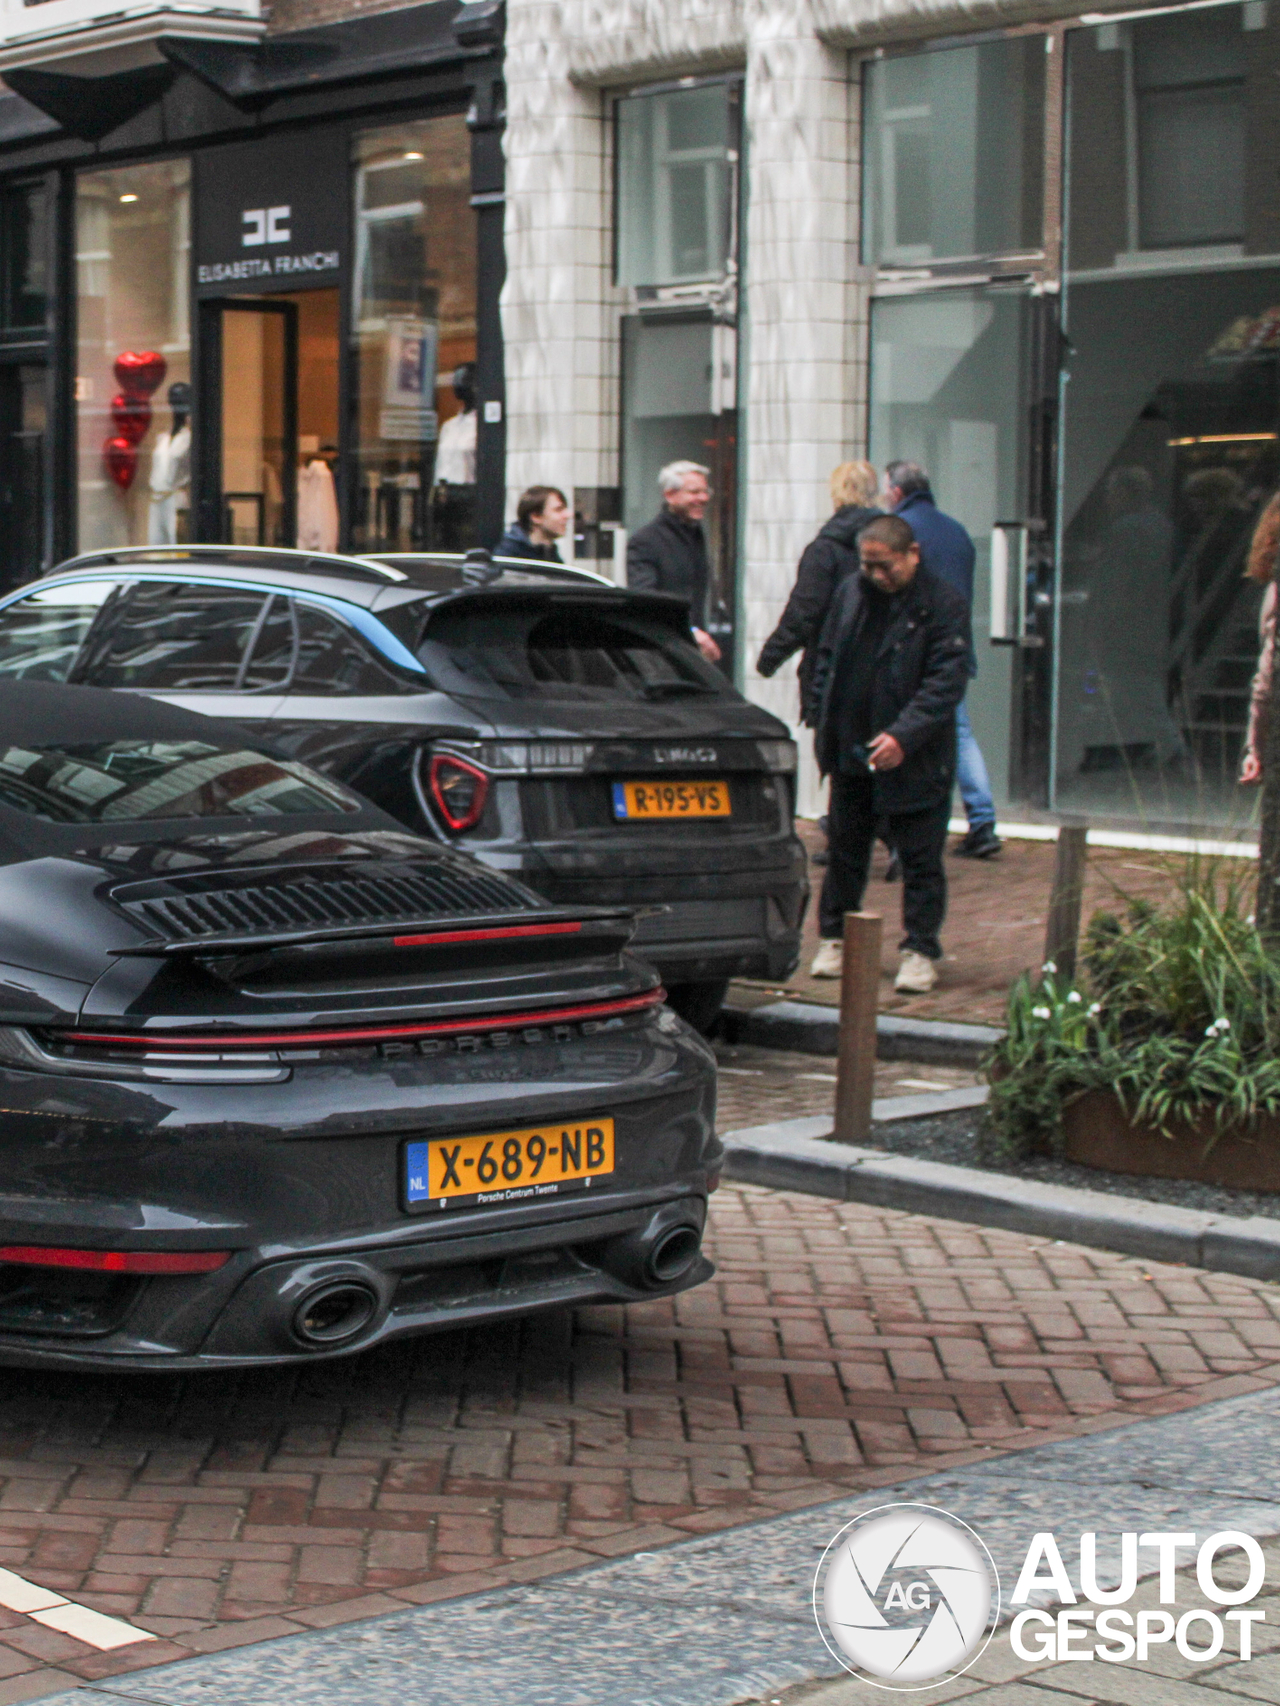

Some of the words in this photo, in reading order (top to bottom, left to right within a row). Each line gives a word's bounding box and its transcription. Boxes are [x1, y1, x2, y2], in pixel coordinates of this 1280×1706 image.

[198, 259, 272, 283] ELISABETTA
[274, 252, 340, 274] FRANCHI
[634, 786, 722, 812] R-195-VS
[438, 1127, 606, 1190] X-689-NB
[410, 1177, 426, 1191] NL
[477, 1192, 505, 1203] Porsche
[505, 1188, 534, 1200] Centrum
[534, 1184, 559, 1195] Twente
